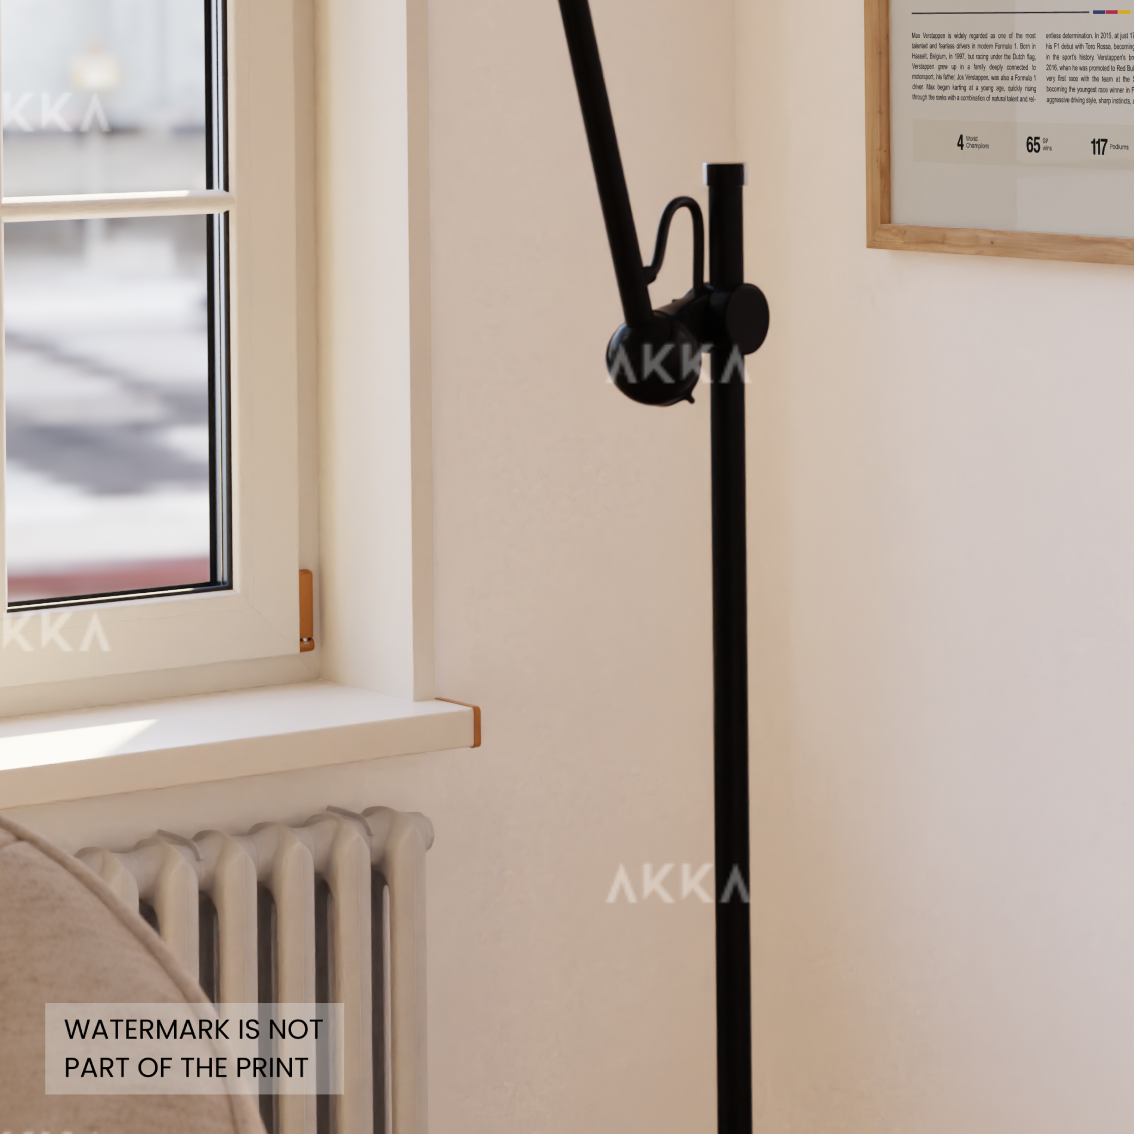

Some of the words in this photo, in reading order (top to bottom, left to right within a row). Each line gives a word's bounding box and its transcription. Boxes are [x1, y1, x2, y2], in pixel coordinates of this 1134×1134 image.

[957, 134, 964, 150] 4
[1026, 136, 1041, 153] 65
[1090, 138, 1108, 155] 117
